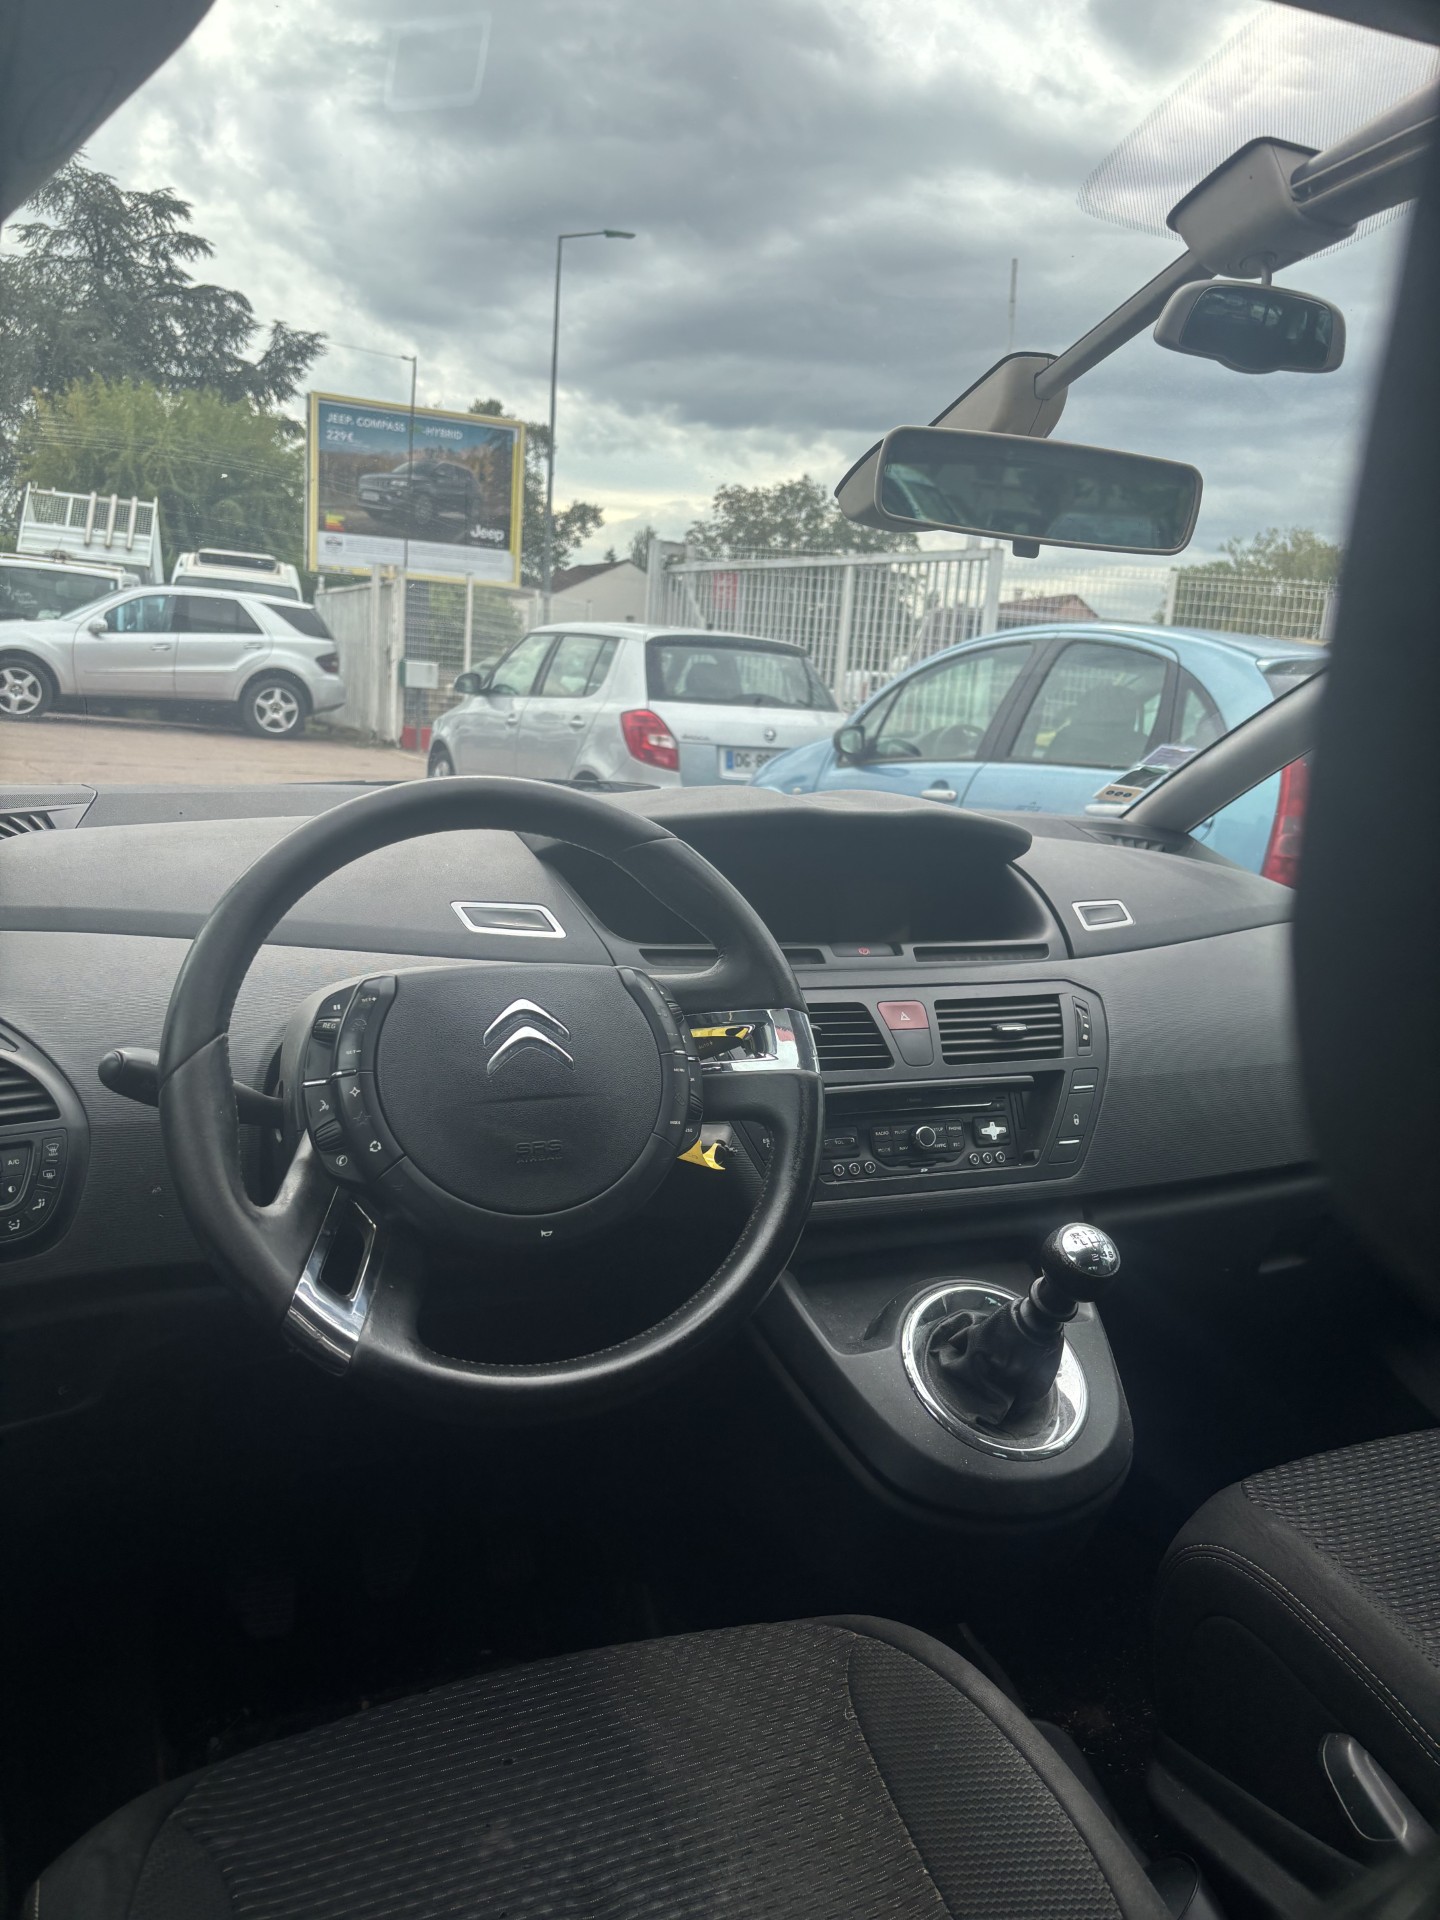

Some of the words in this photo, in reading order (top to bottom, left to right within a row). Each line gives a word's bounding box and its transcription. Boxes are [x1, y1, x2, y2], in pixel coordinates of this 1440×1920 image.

[355, 416, 406, 433] COMPASS
[469, 524, 505, 543] Jeep
[322, 1022, 337, 1030] REG
[514, 1139, 563, 1154] SRS
